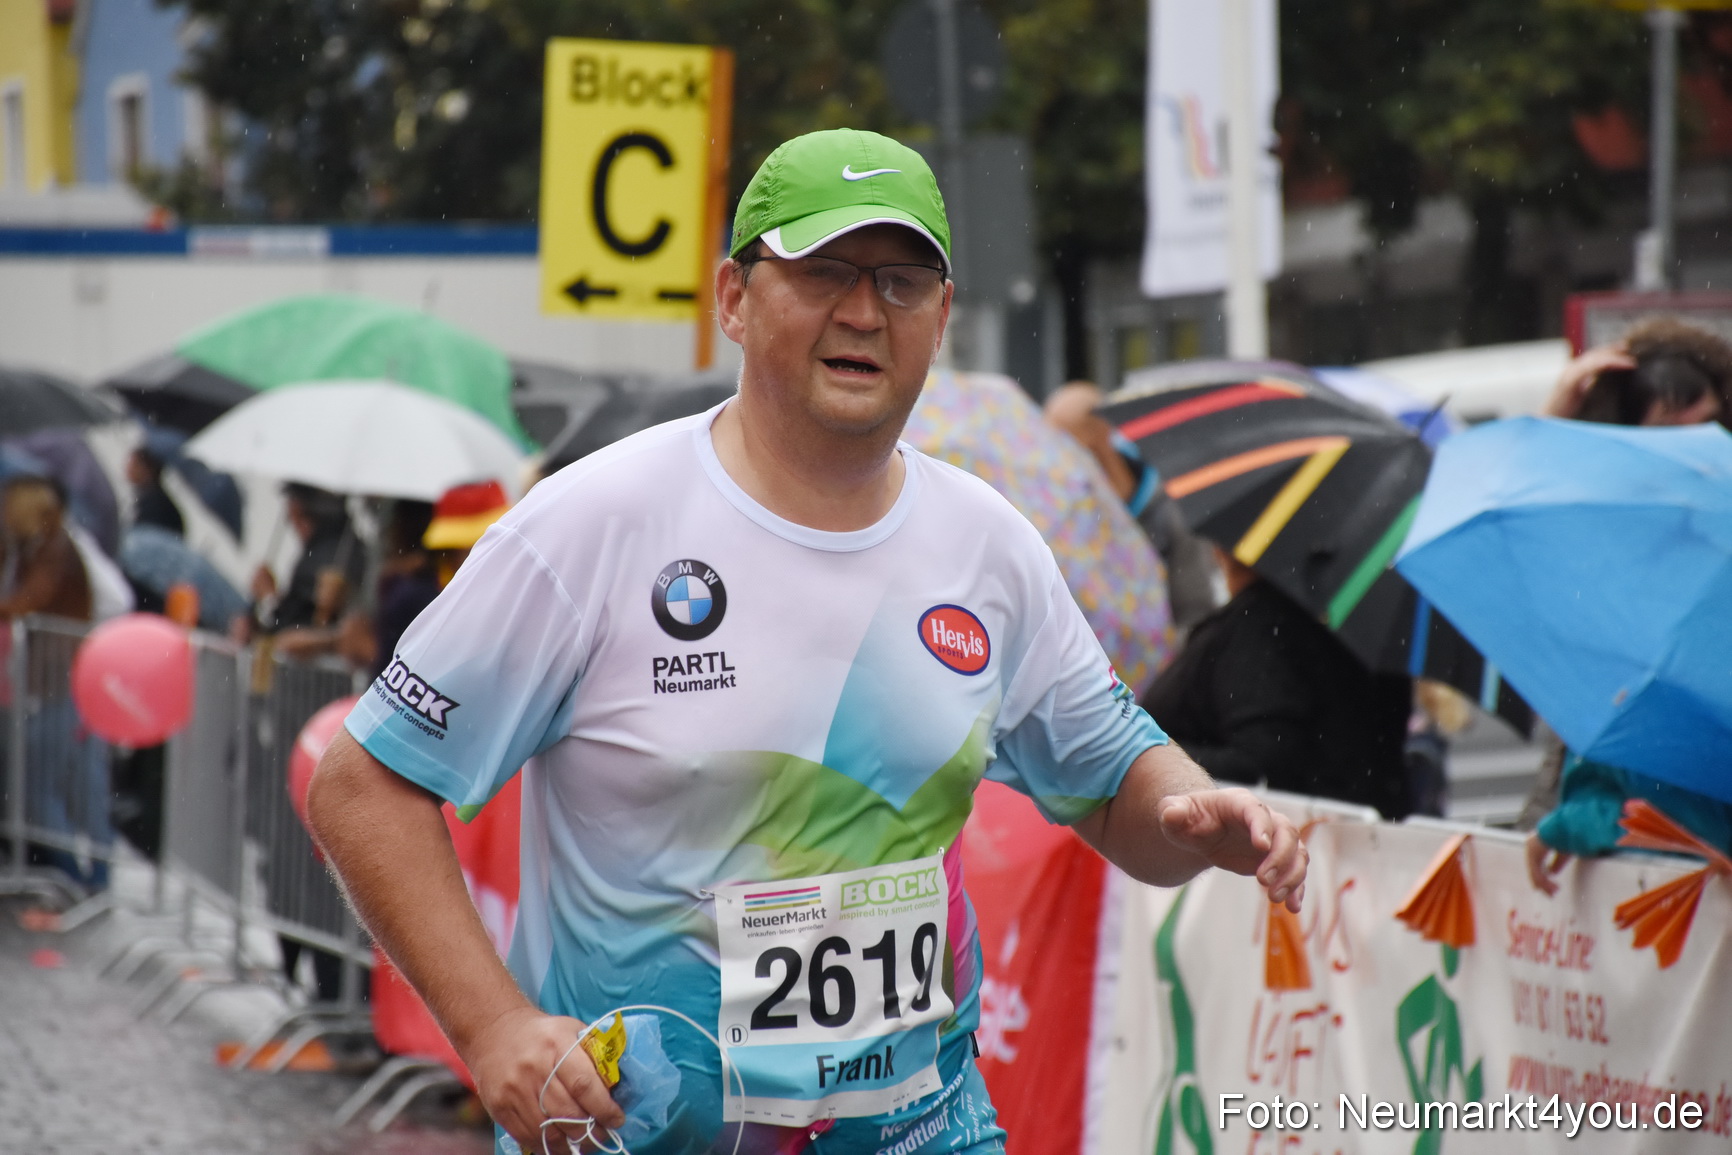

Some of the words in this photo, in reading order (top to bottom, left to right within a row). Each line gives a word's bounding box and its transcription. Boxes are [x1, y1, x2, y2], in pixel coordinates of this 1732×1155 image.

[568, 54, 708, 107] Block
[590, 131, 674, 256] C
[657, 561, 719, 590] BMW
[931, 618, 984, 658] Hervis
[652, 651, 736, 679] PARTL
[937, 646, 964, 660] SPORTS
[653, 673, 737, 695] Neumarkt
[385, 697, 405, 716] smart
[403, 711, 445, 741] concepts
[840, 866, 940, 911] BOCK
[741, 907, 827, 929] NeuerMarkt
[838, 907, 875, 921] inspired
[877, 906, 889, 917] by
[891, 903, 913, 914] smart
[747, 929, 777, 939] einkaufen
[779, 927, 796, 936] leben
[750, 921, 938, 1031] 2619
[731, 1027, 742, 1043] D
[816, 1045, 895, 1089] Frank
